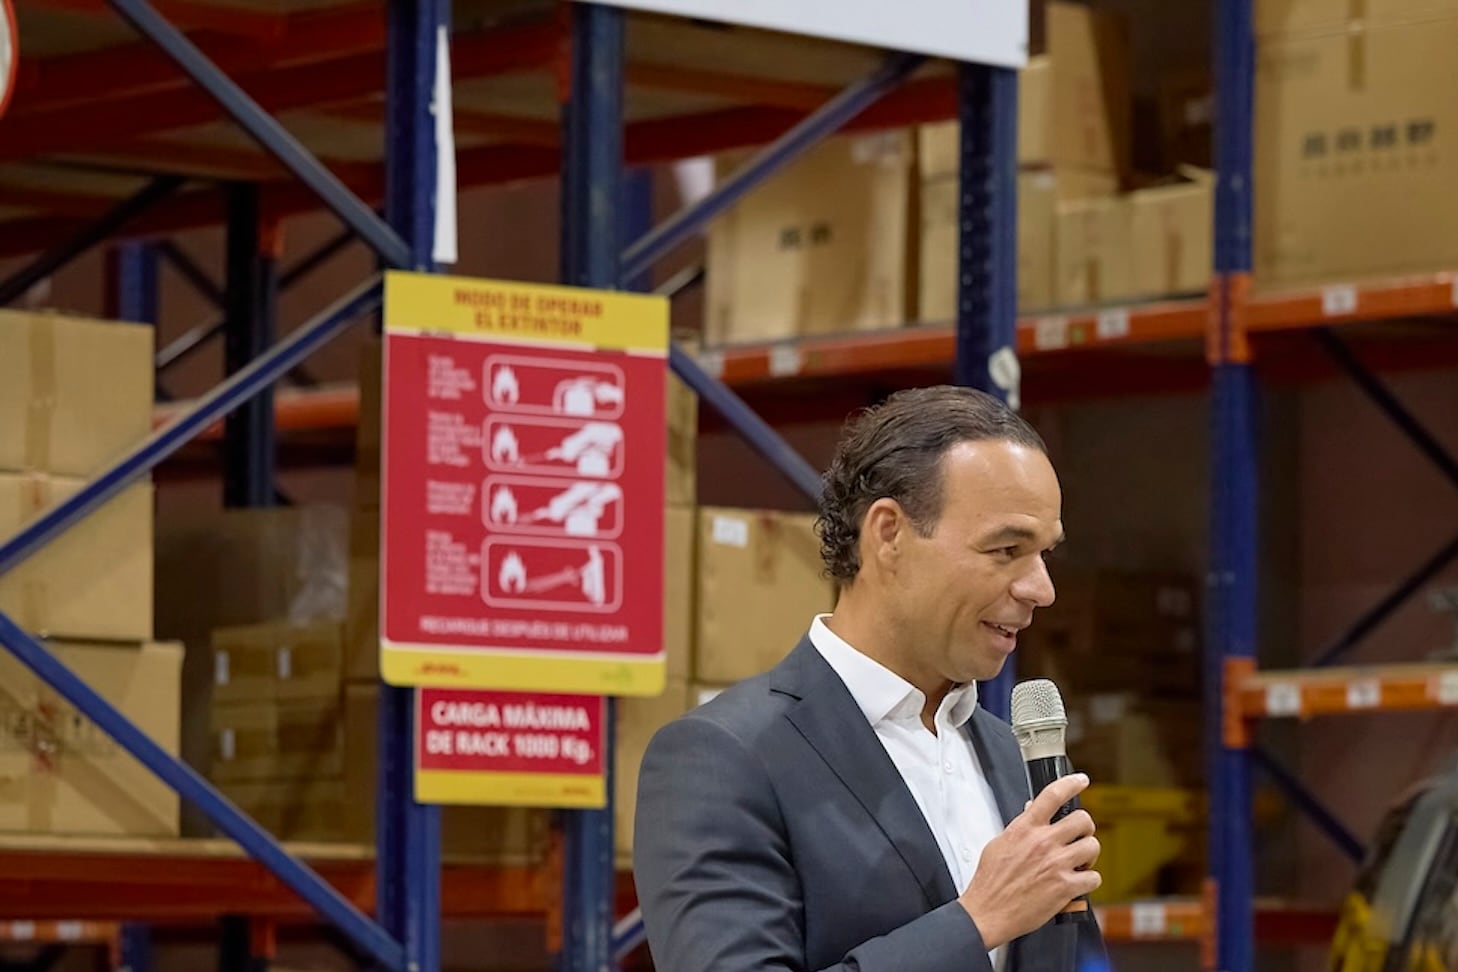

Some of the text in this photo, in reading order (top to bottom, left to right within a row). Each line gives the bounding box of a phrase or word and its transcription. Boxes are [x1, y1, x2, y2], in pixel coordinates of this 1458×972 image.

[454, 289, 603, 316] MODO DE OPERAR
[475, 311, 581, 336] EL EXTINTOR
[431, 701, 590, 731] CARGA MÁXIMA
[426, 730, 453, 755] DE
[456, 731, 509, 757] RACK
[514, 734, 559, 759] 1000
